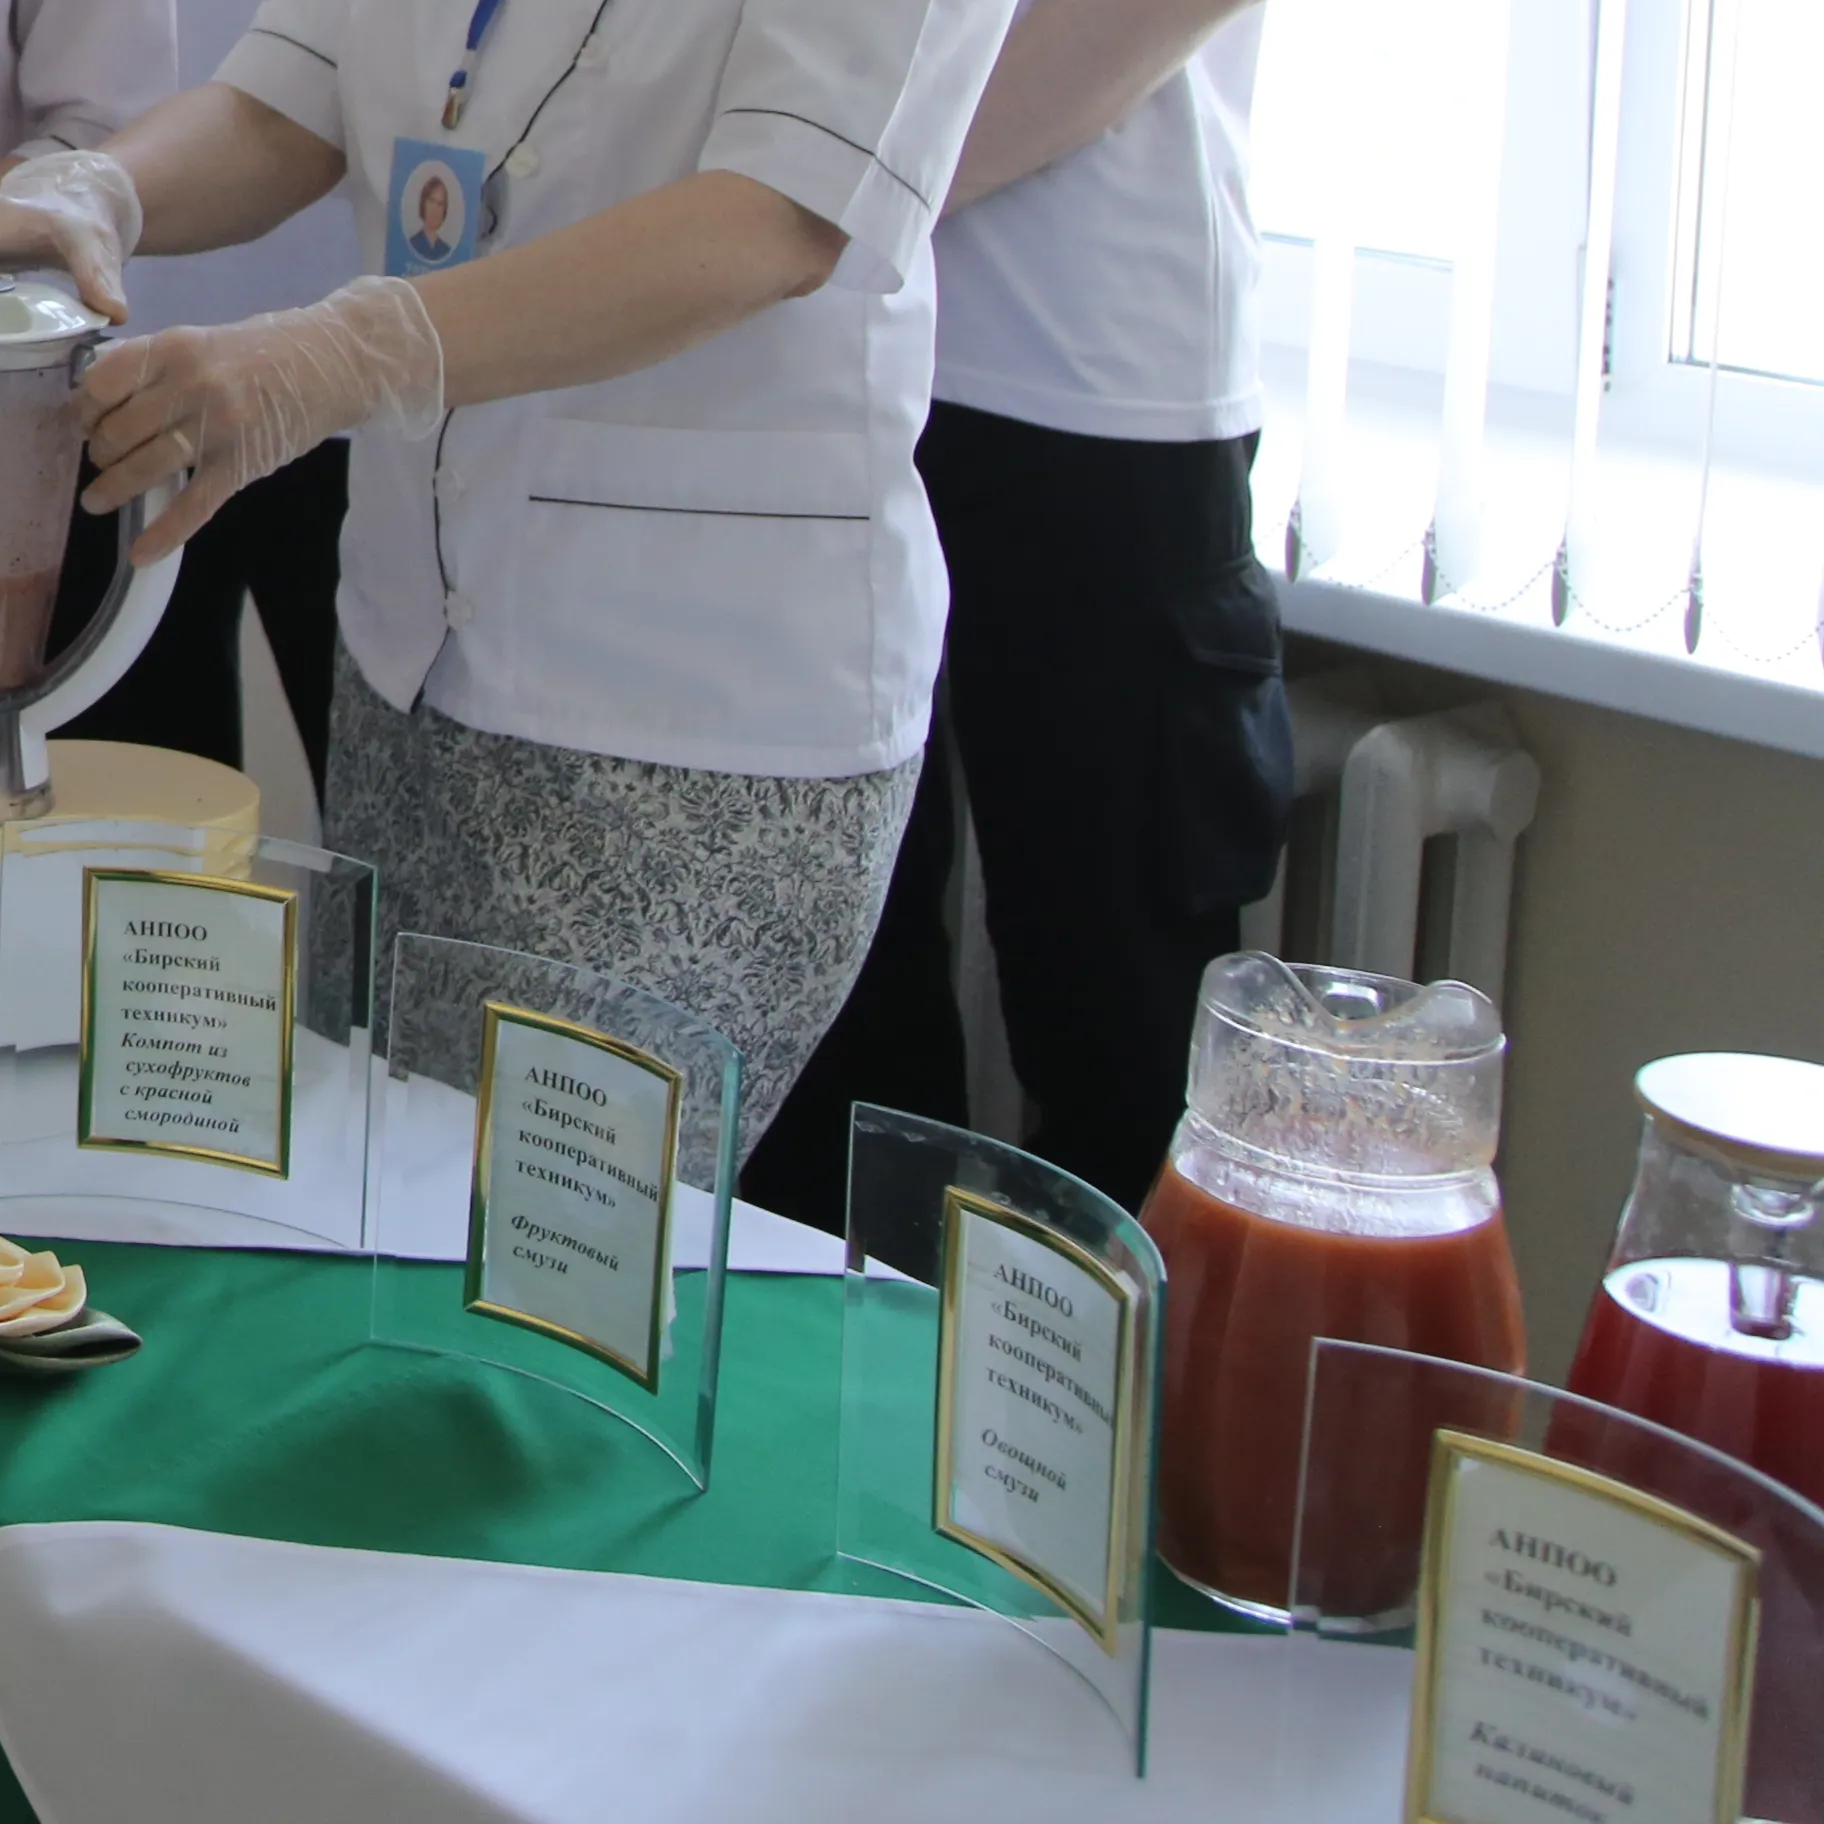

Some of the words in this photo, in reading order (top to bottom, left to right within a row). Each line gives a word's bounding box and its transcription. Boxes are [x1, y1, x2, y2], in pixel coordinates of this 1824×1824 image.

[124, 921, 208, 942] АНПОО
[123, 948, 221, 972] «Бирский
[121, 1007, 228, 1030] техникум»
[122, 980, 277, 1012] кооперативный
[121, 1032, 202, 1055] Компот
[208, 1045, 228, 1058] из
[120, 1084, 130, 1096] с
[135, 1085, 213, 1104] красной
[126, 1060, 252, 1087] сухофруктов
[525, 1066, 607, 1107] АНПОО
[125, 1108, 240, 1134] смородиной
[522, 1096, 617, 1145] «Бирский
[516, 1160, 616, 1209] техникум»
[519, 1129, 658, 1203] кооперативный
[511, 1214, 619, 1272] Фруктовый
[513, 1245, 568, 1274] смузи
[994, 1263, 1073, 1318] АНПОО
[991, 1300, 1082, 1362] «Бирский
[986, 1367, 1083, 1435] техникум»
[988, 1334, 1115, 1430] кооперативны
[982, 1428, 1067, 1492] Овощной
[984, 1464, 1040, 1503] смузи
[1489, 1528, 1617, 1588] АНПОО
[1484, 1568, 1632, 1638] «Бирский
[1481, 1608, 1709, 1720] кооперативный
